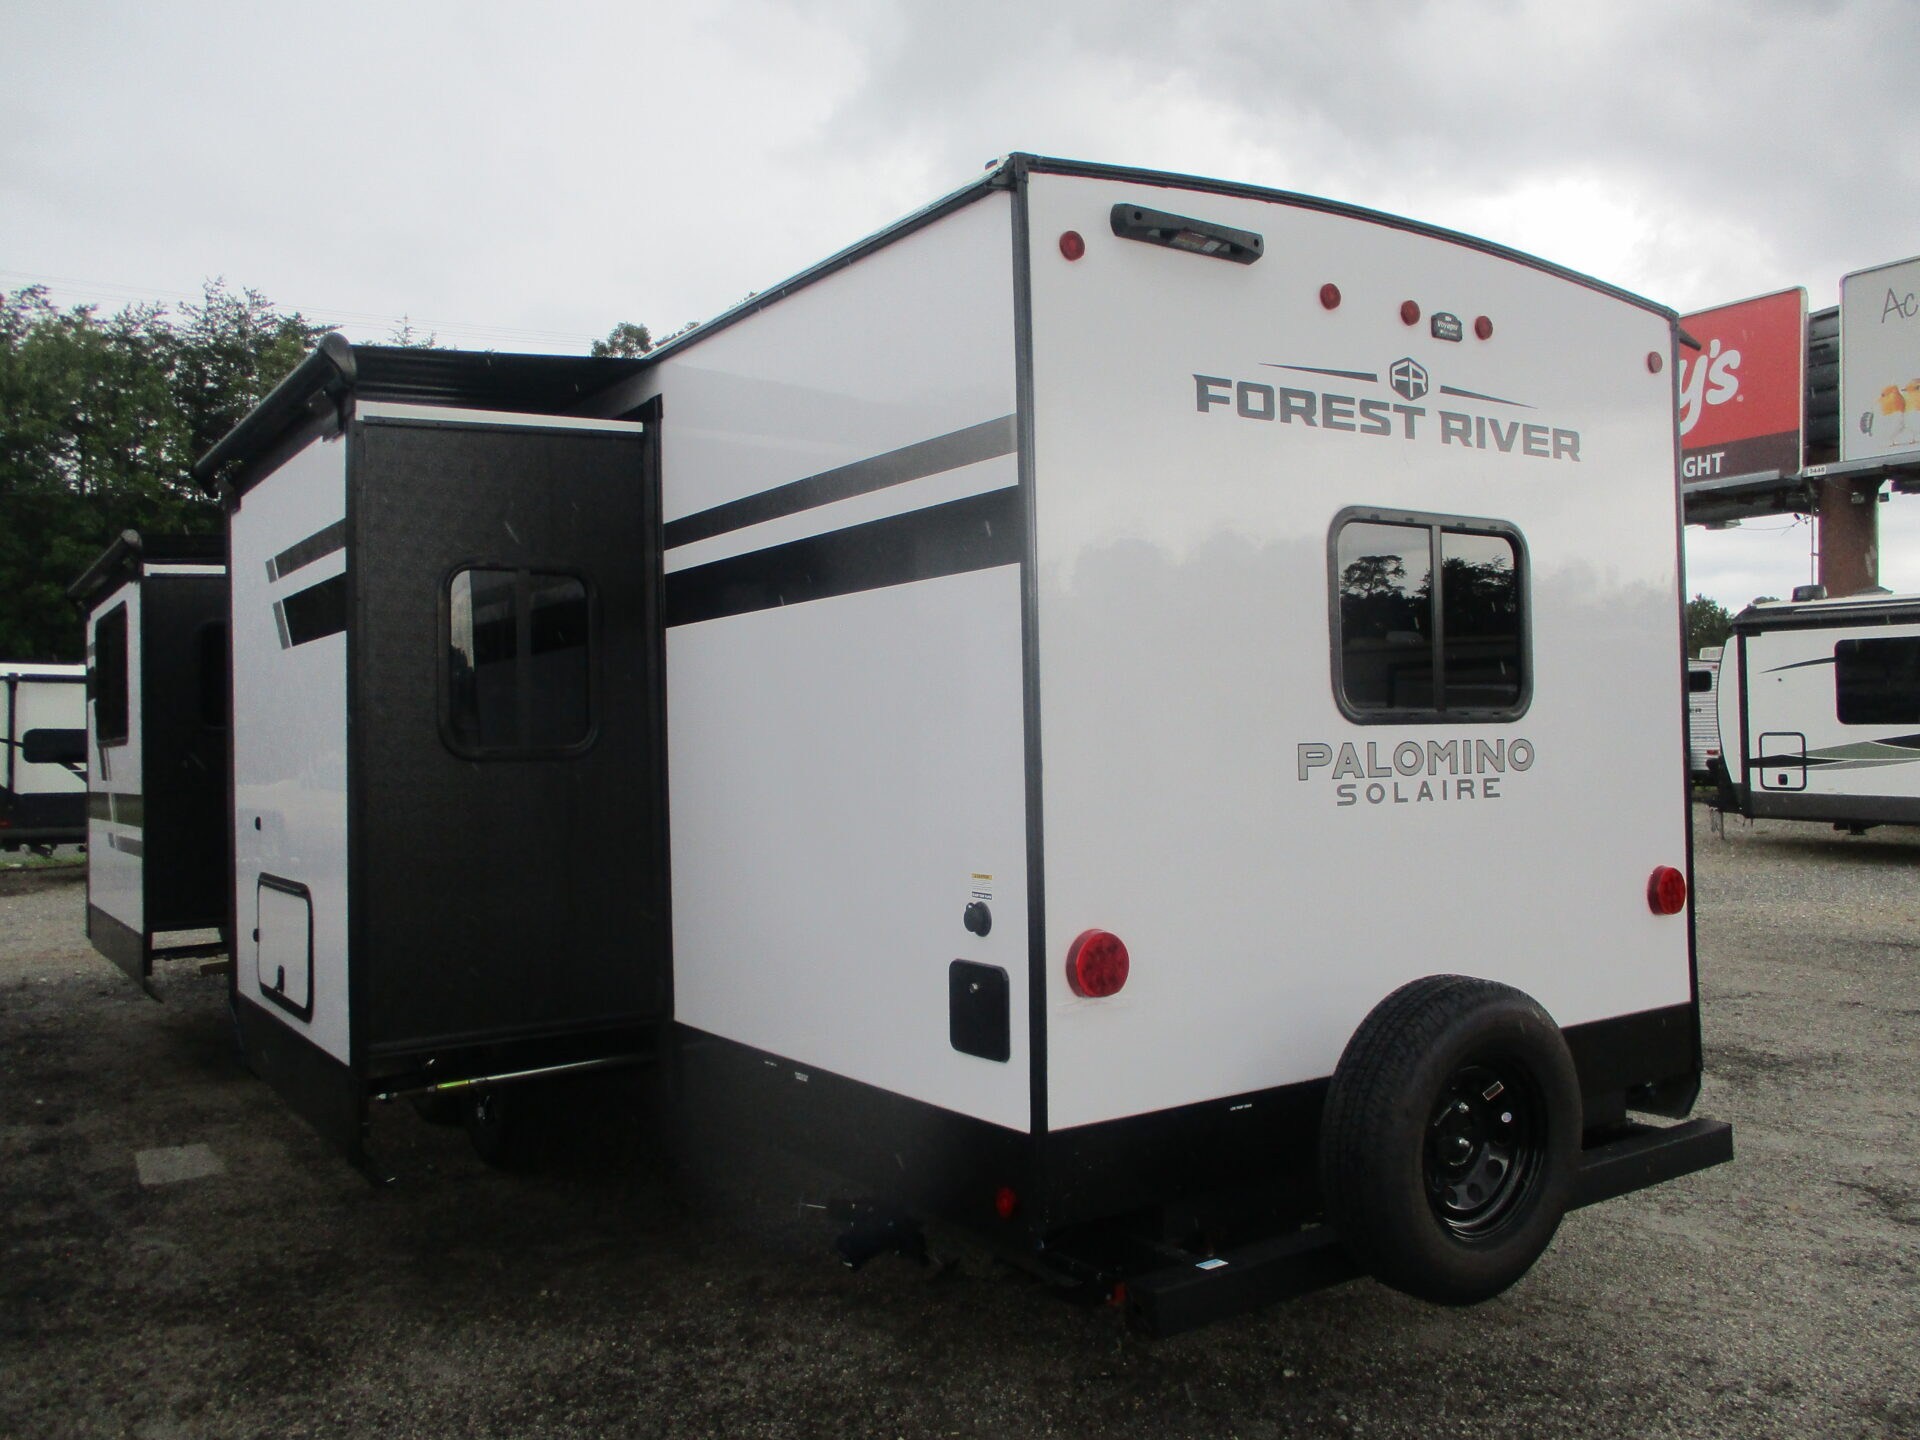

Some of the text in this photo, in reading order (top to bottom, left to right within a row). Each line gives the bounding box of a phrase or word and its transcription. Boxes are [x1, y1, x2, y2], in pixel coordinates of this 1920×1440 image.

[1192, 374, 1581, 462] FOREST RIVER
[1683, 451, 1725, 478] GHT
[1297, 738, 1535, 781] PALOMINO
[1336, 777, 1501, 806] SOLAIRE
